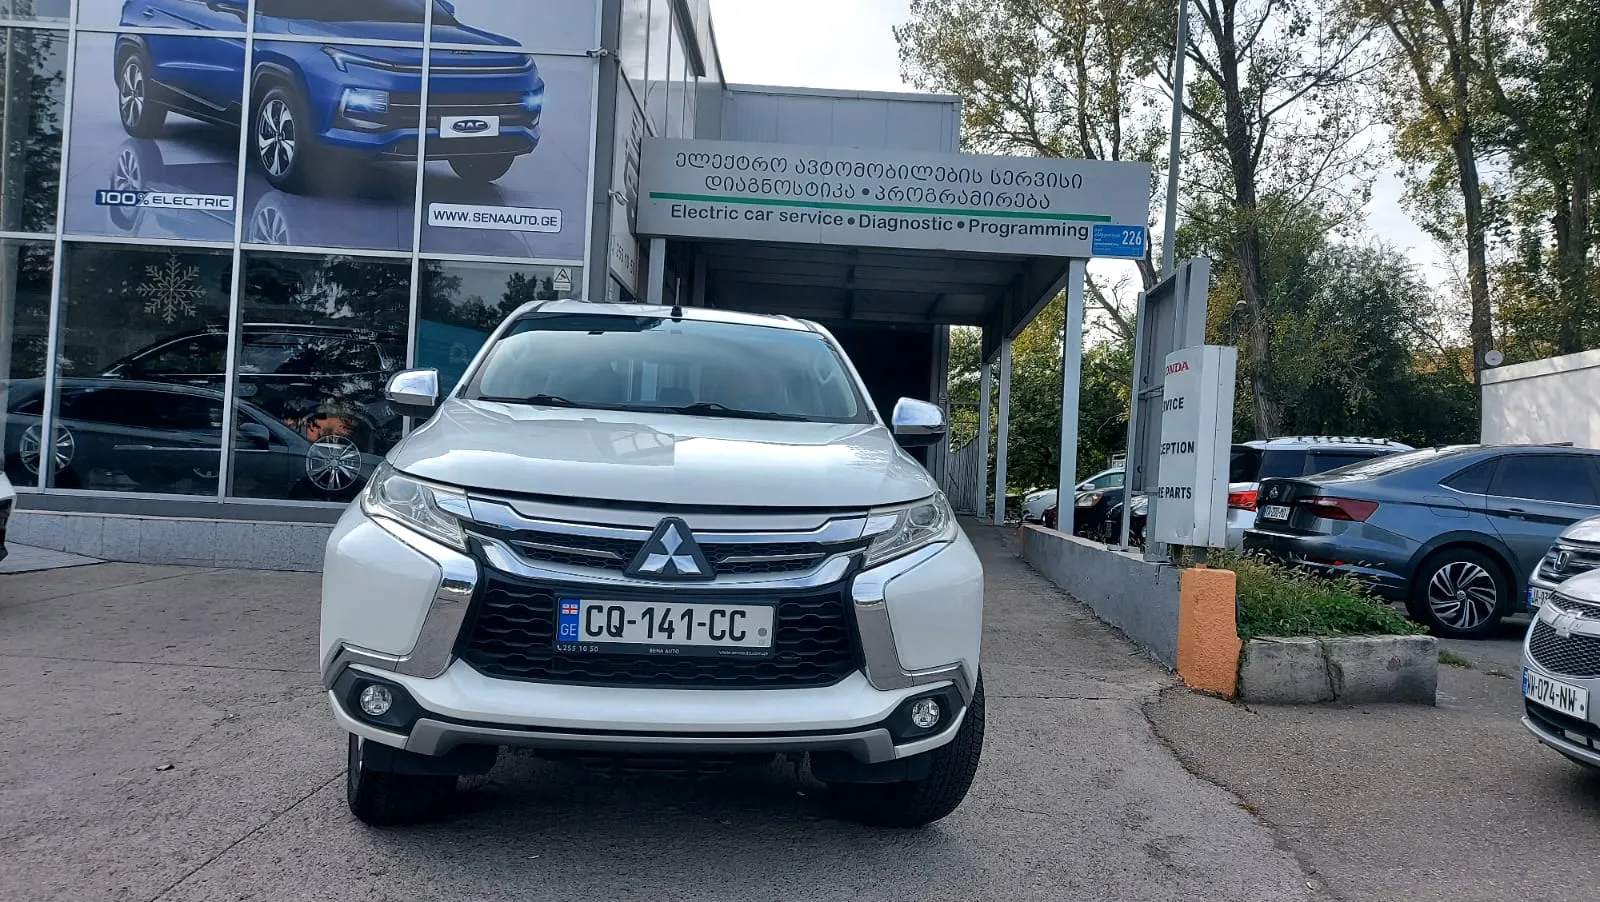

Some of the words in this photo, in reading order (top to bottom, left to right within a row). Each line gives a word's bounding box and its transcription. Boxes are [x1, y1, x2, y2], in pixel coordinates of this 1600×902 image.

[676, 152, 788, 173] ელექტრო
[795, 159, 983, 184] ავტომობილების
[990, 168, 1083, 189] სერვისი
[101, 191, 150, 205] 100%
[152, 195, 229, 208] ELECTRIC
[705, 175, 855, 199] დიაგნოსტიკა
[875, 185, 1050, 209] პროგრამირება
[433, 210, 558, 227] WWW.SENAAUTO.GE
[671, 204, 739, 220] Electric
[744, 210, 774, 222] car
[779, 210, 843, 226] service
[859, 214, 953, 232] Diagnostic
[969, 219, 1089, 241] Programming
[1122, 230, 1142, 246] 226
[1165, 486, 1192, 499] PARTS
[560, 623, 577, 636] GE
[585, 604, 746, 642] CQ-141-CC
[562, 644, 576, 652] 255
